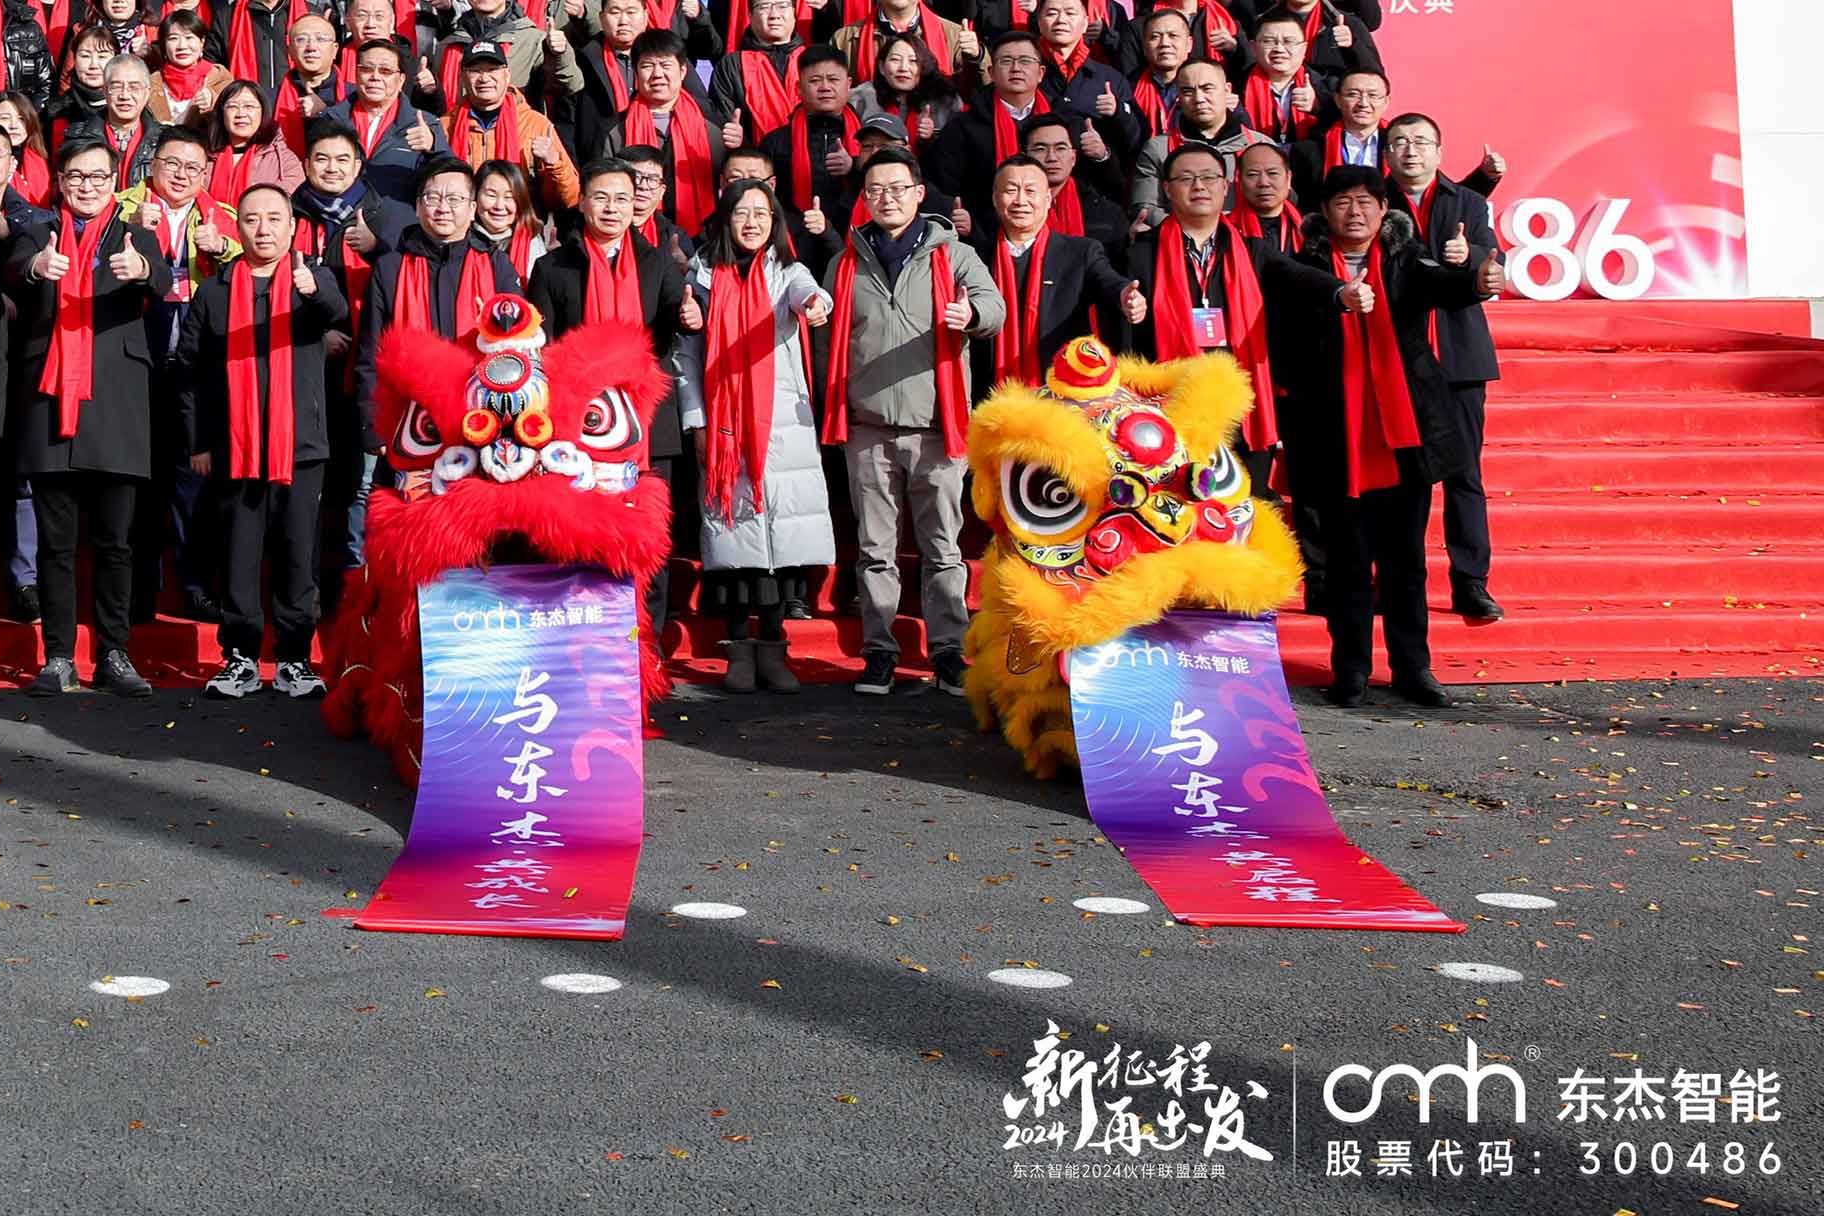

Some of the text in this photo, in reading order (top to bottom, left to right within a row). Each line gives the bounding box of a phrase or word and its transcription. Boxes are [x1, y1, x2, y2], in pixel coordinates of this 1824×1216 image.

[1487, 197, 1656, 302] 86
[529, 605, 604, 630] 东杰智能
[1176, 650, 1251, 674] 东杰智能
